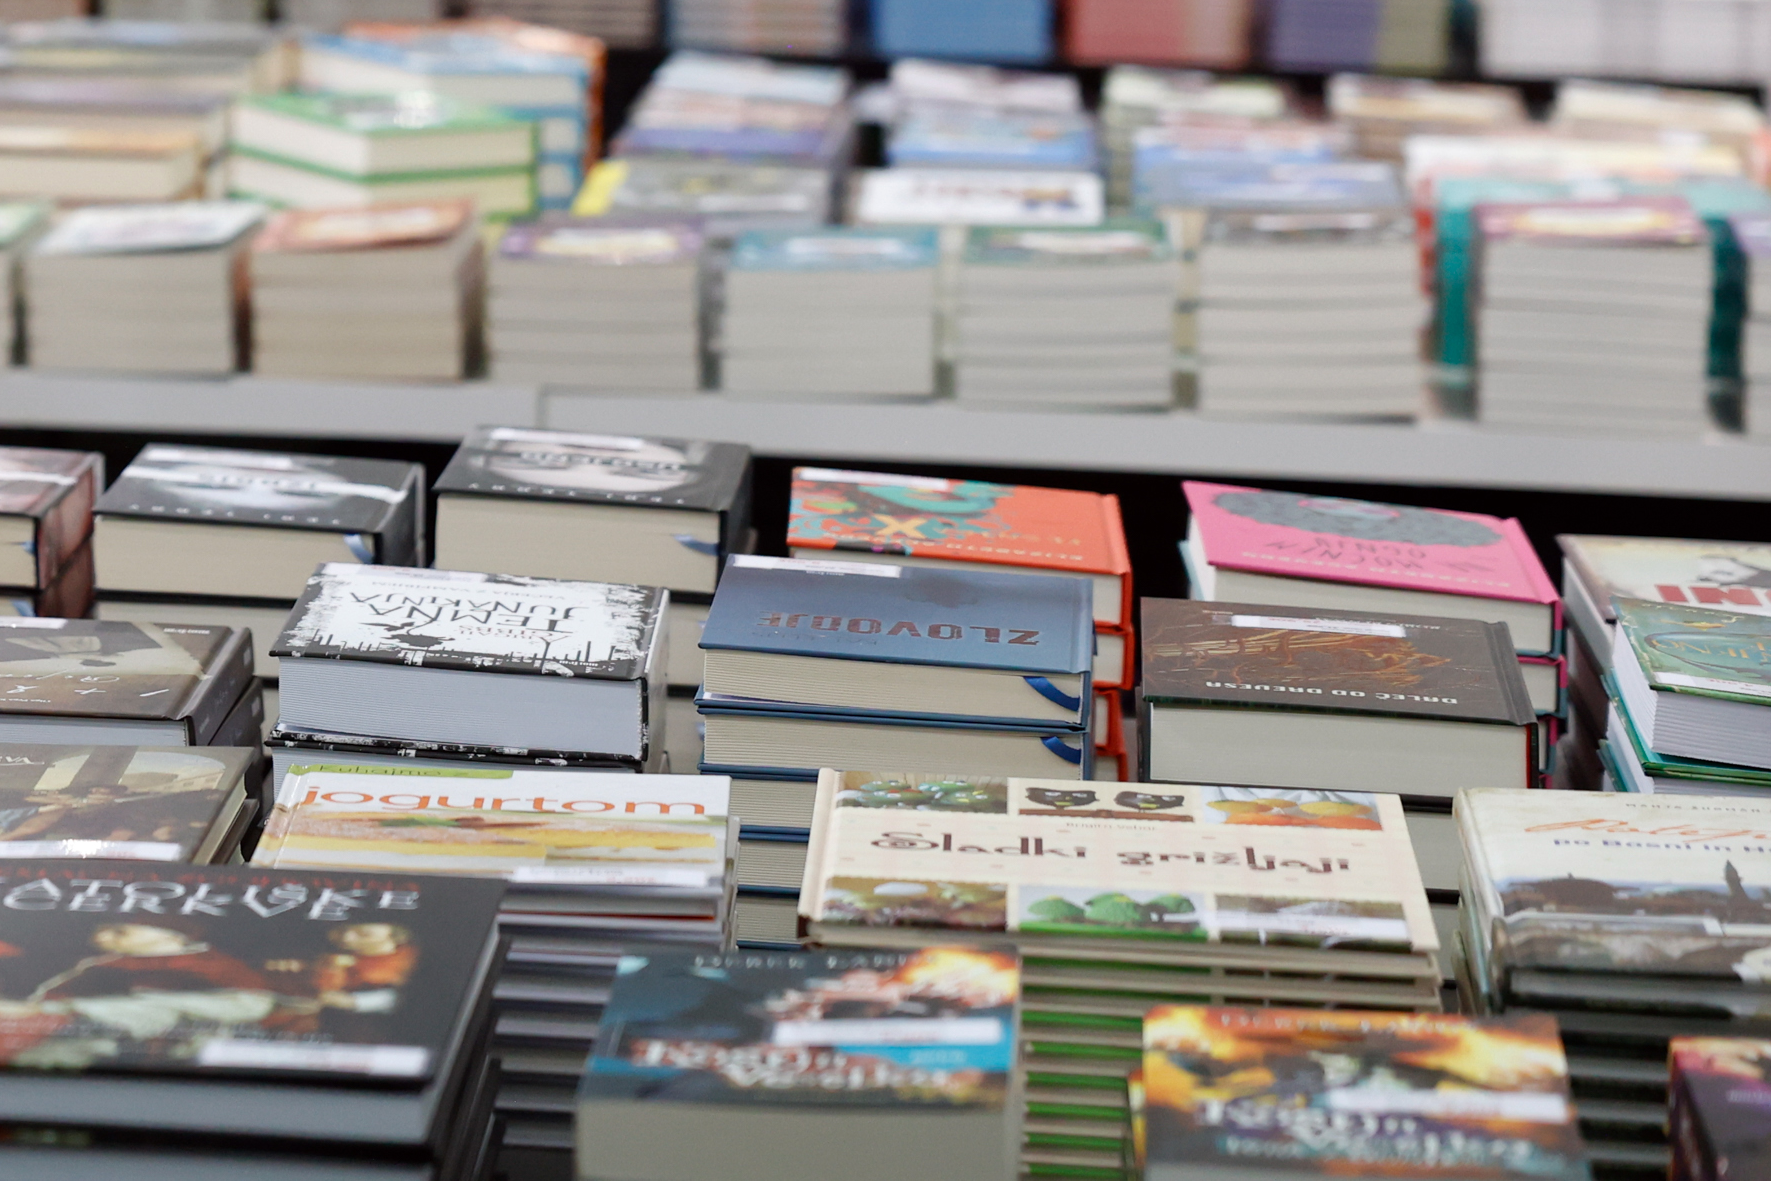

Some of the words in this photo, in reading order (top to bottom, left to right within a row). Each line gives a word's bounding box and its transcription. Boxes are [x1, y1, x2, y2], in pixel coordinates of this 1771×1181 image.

[350, 591, 590, 620] JUNAKINJA
[1653, 584, 1771, 606] IN
[369, 603, 573, 633] TEMNA
[756, 611, 1041, 645] ZLOVODJE
[1205, 680, 1323, 695] DREVESA
[1331, 688, 1367, 698] OD
[1375, 691, 1459, 705] DALEČ
[300, 785, 706, 816] jogurtom
[870, 829, 1087, 859] Sladki
[1602, 839, 1692, 850] Bosni
[3, 885, 352, 920] CERKVE
